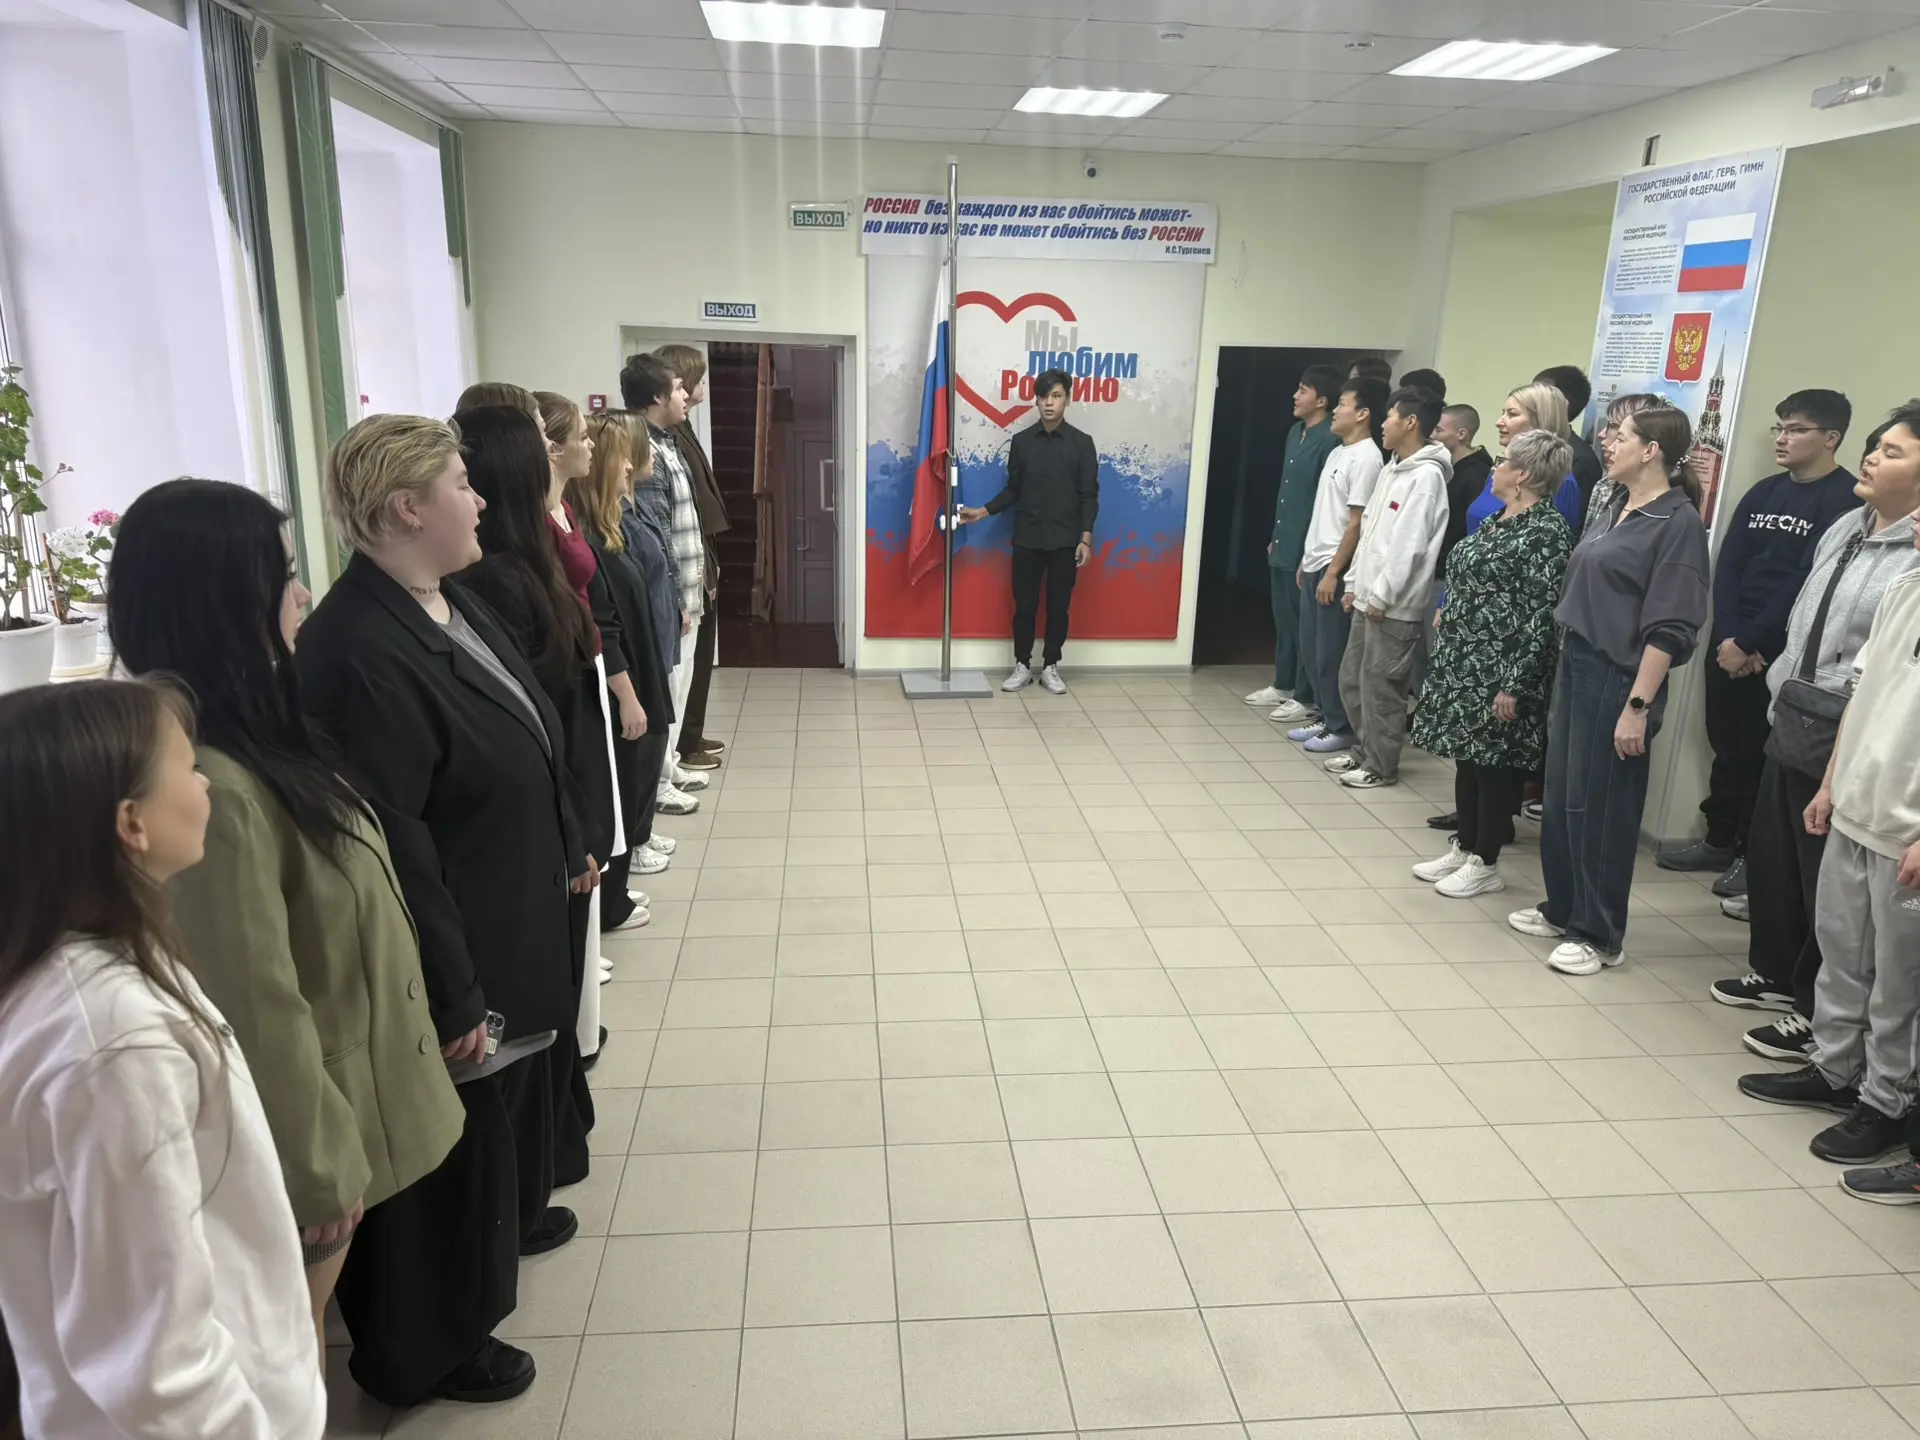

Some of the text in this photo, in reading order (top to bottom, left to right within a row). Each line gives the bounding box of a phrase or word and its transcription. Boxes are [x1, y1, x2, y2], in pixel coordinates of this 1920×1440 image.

[1627, 160, 1764, 194] ГОСУДАРСТВЕННЫЙ ФЛАГ, ГЕРБ, ГИМН
[1643, 180, 1736, 204] РОССИЙСКОЙ ФЕДЕРАЦИИ
[795, 211, 843, 226] ВЫХОД
[863, 197, 921, 215] РОССИЯ
[924, 199, 949, 216] без
[1018, 205, 1038, 218] из
[1039, 205, 1067, 219] нас
[1067, 203, 1136, 220] обойтись
[1138, 208, 1192, 222] может-
[863, 219, 883, 233] но
[883, 220, 928, 235] никто
[929, 222, 949, 236] из
[979, 223, 999, 237] не
[999, 223, 1049, 238] может
[1050, 222, 1119, 240] обойтись
[1120, 225, 1148, 241] без
[1148, 225, 1205, 242] РОССИИ
[706, 303, 754, 318] ВЫХОД
[1024, 319, 1078, 352] Мы
[1026, 346, 1138, 379] любим
[1000, 369, 1120, 403] Роию
